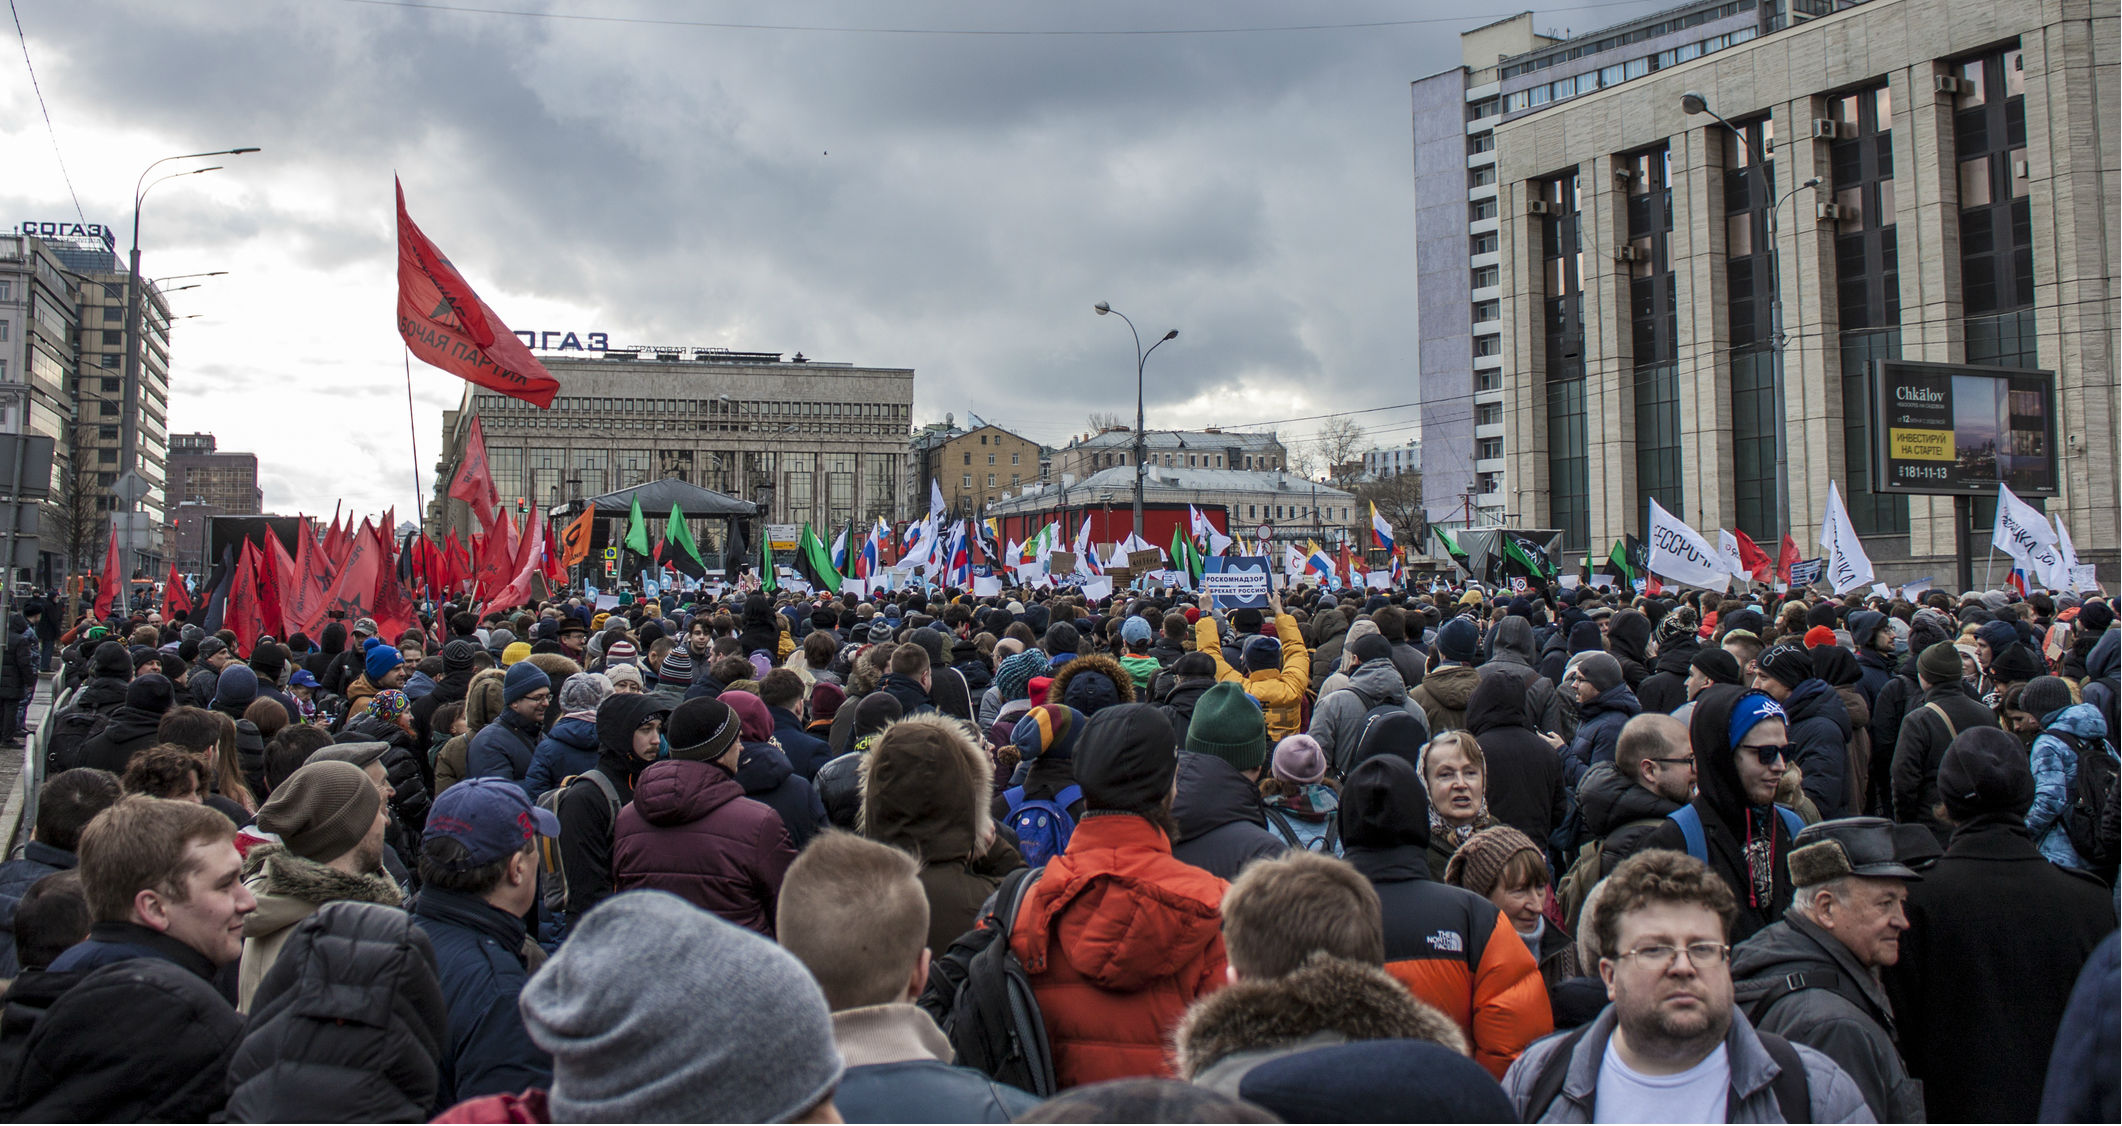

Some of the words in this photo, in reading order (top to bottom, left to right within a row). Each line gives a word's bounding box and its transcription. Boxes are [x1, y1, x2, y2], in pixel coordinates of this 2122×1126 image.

[23, 221, 102, 237] СОГАЗ
[1896, 386, 1944, 402] Chkālov
[1902, 415, 1910, 423] 12
[1897, 433, 1946, 444] ИНВЕСТИРУЙ
[1901, 445, 1913, 454] НА
[1905, 466, 1948, 479] 181-11-13
[517, 811, 534, 840] 3
[1426, 936, 1451, 944] NORTH
